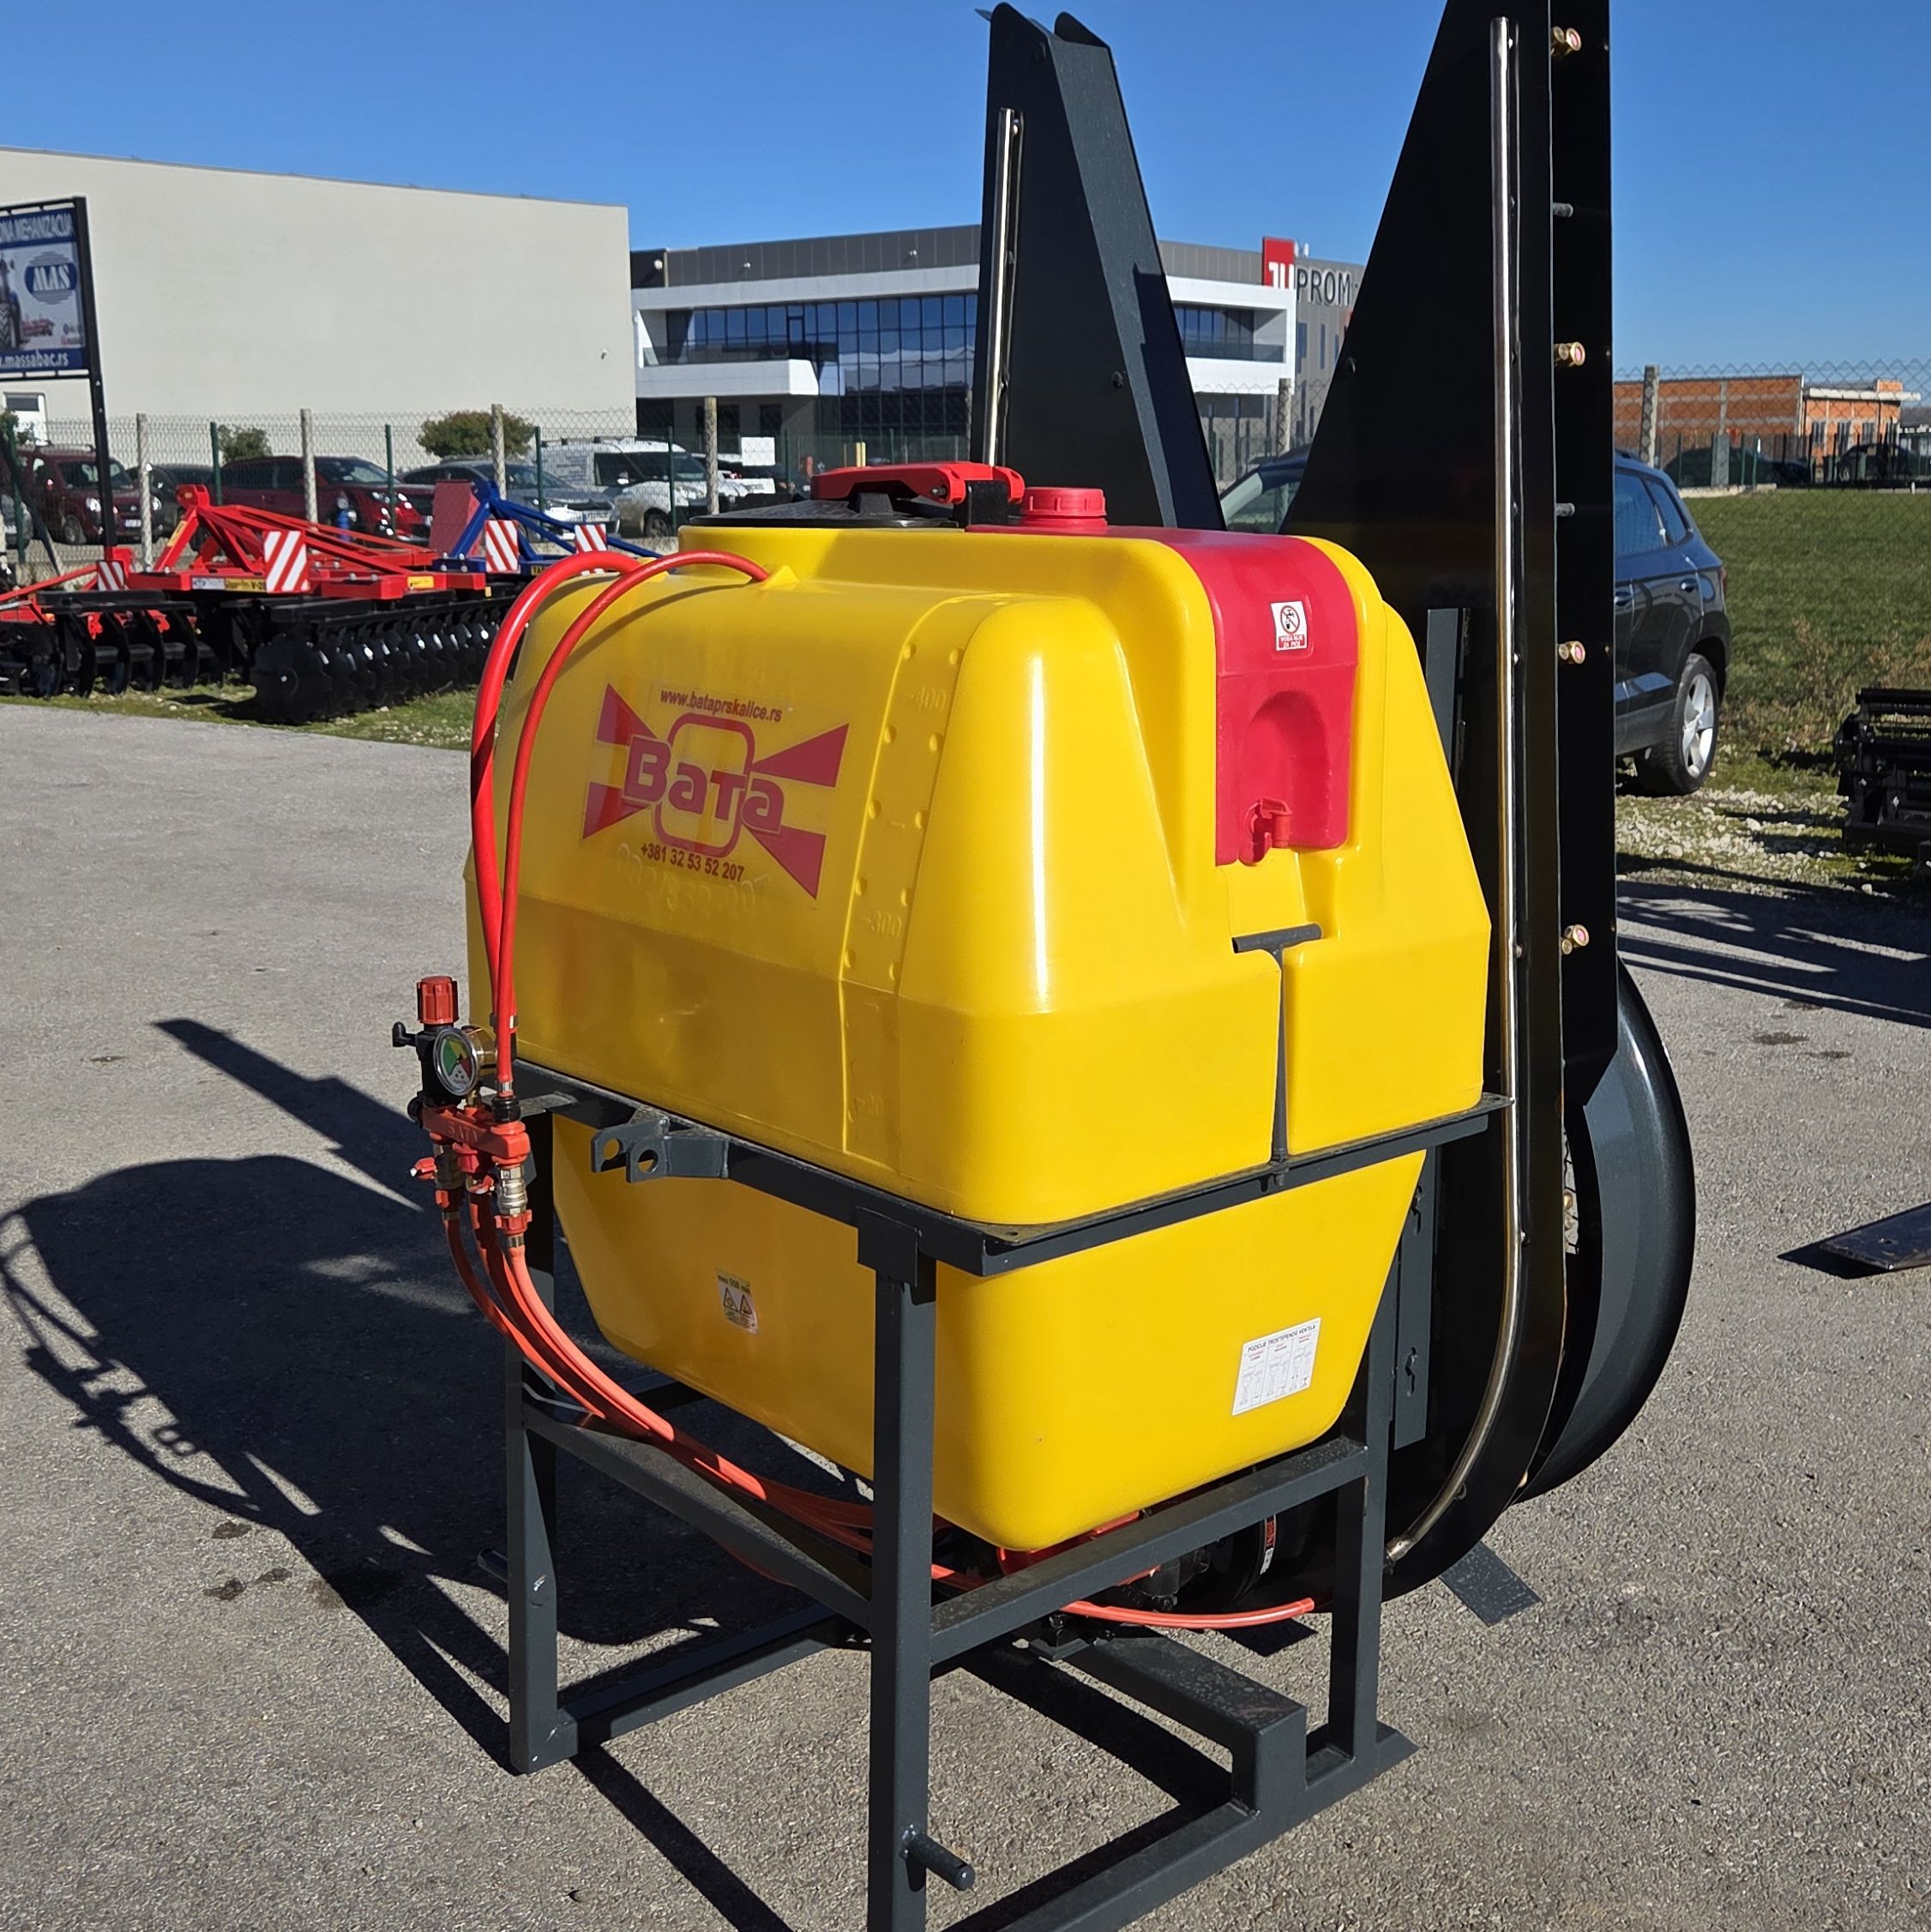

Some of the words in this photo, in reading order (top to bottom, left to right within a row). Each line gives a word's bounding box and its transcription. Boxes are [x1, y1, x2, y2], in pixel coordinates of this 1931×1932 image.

[33, 263, 70, 292] MAS
[1296, 268, 1350, 305] PROM
[0, 348, 69, 370] .massabac.rs
[660, 689, 782, 723] www.bataprskalice.rs
[641, 842, 667, 864] +381
[670, 848, 685, 868] 32
[687, 853, 702, 872] 53
[704, 858, 719, 876] 52
[721, 862, 745, 882] 207
